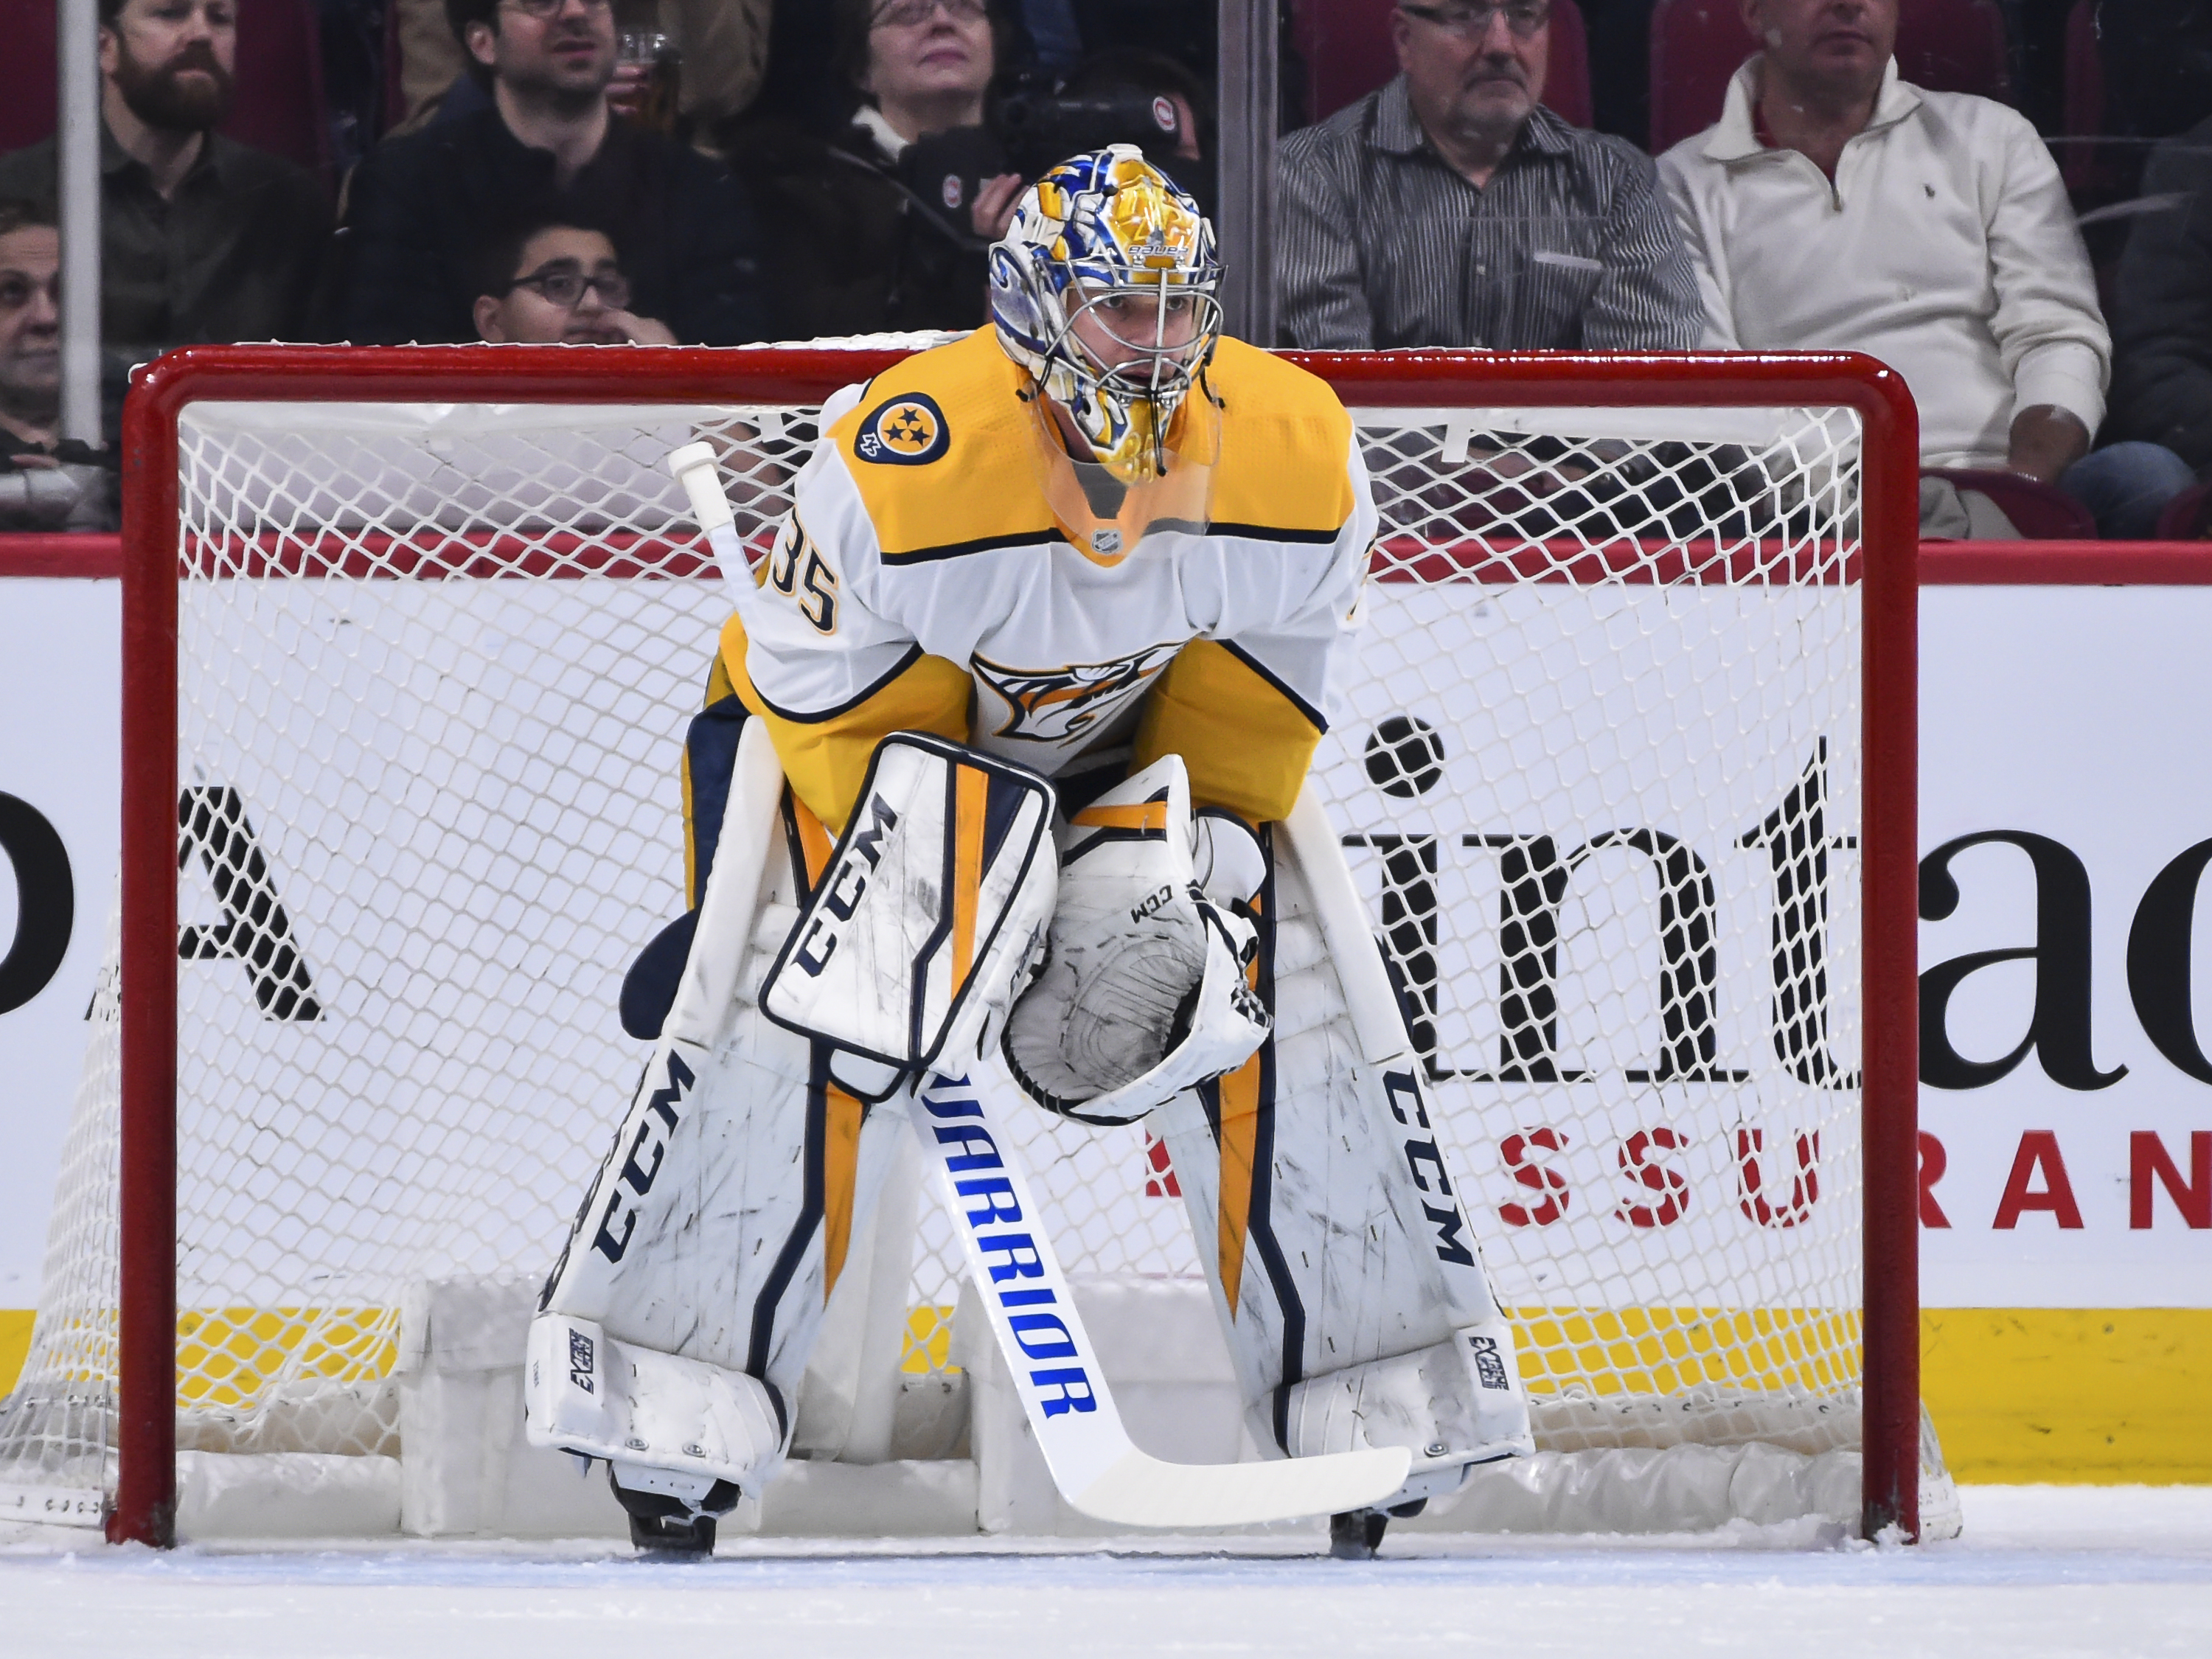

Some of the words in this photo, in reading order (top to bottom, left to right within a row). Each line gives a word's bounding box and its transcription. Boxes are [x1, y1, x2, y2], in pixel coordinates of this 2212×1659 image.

[771, 504, 839, 636] 35
[790, 791, 898, 978] CCM
[1130, 885, 1174, 925] CCM
[590, 1048, 696, 1265] CCM
[1382, 1065, 1475, 1267] CCM
